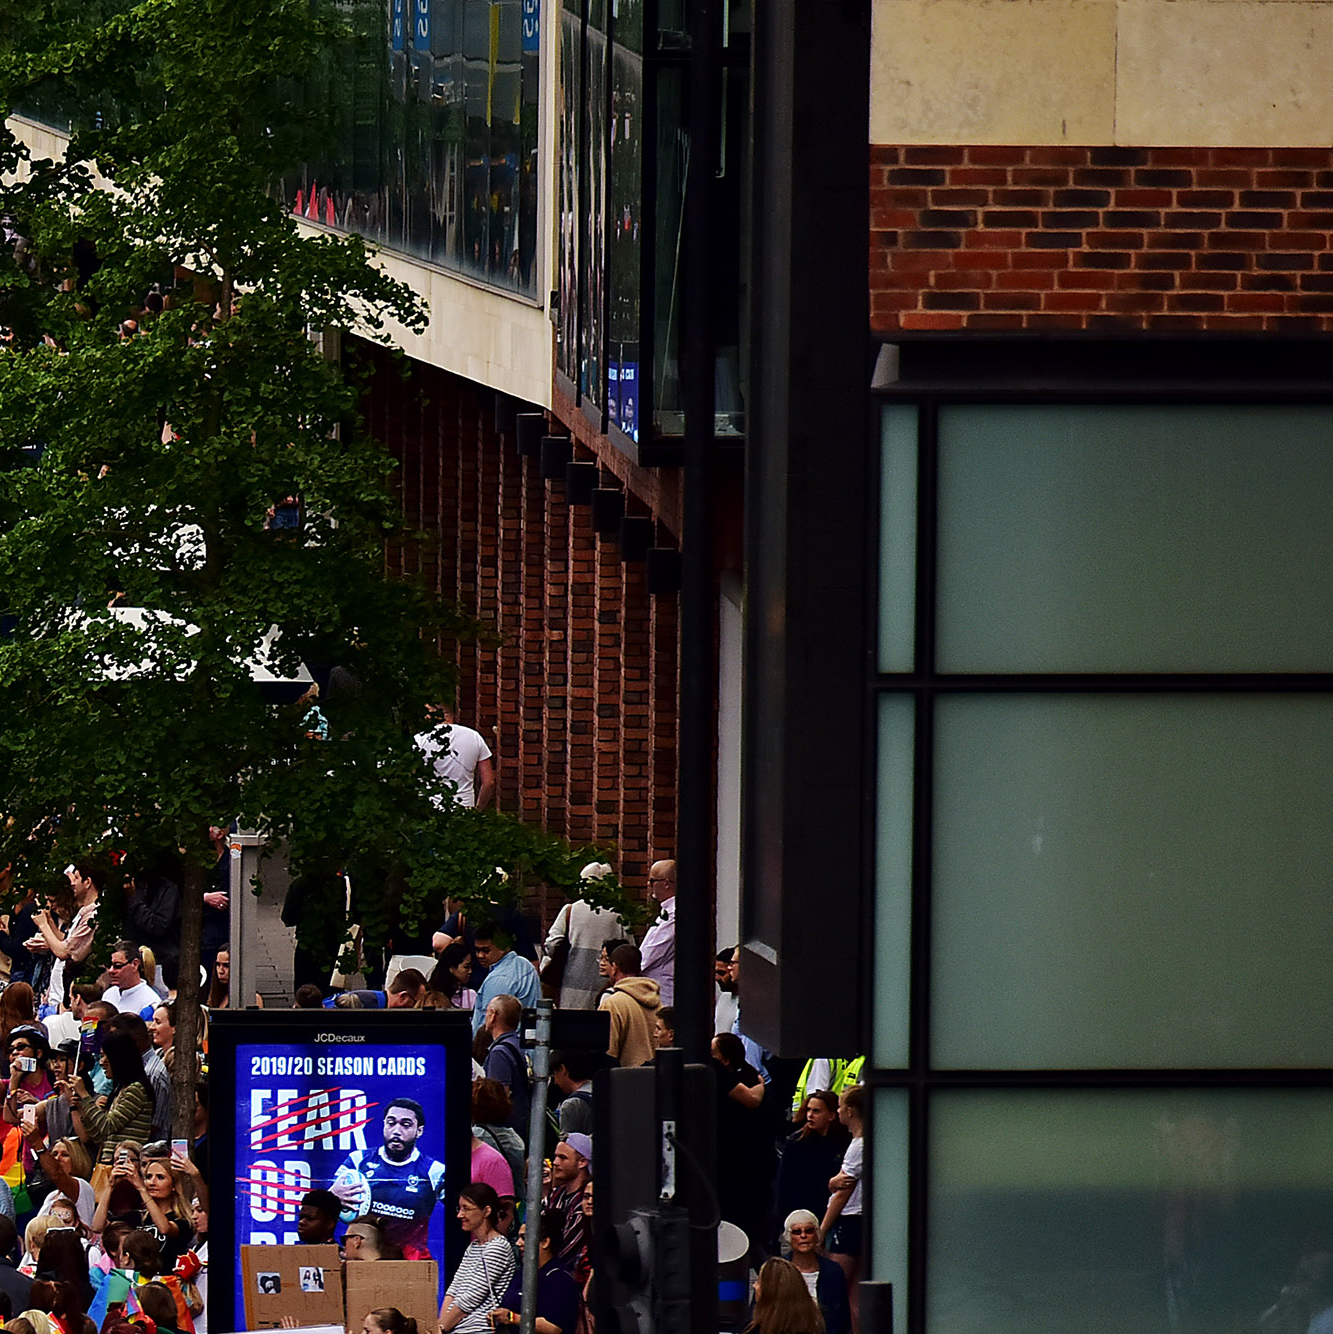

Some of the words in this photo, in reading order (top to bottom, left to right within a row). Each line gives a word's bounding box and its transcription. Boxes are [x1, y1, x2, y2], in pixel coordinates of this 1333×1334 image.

[313, 1033, 365, 1043] JCDecaux
[251, 1057, 313, 1076] 2019/20
[317, 1057, 374, 1076] SEASON
[377, 1057, 427, 1076] CARDS
[249, 1089, 367, 1151] FEAR
[372, 1202, 415, 1216] TOOGOOD
